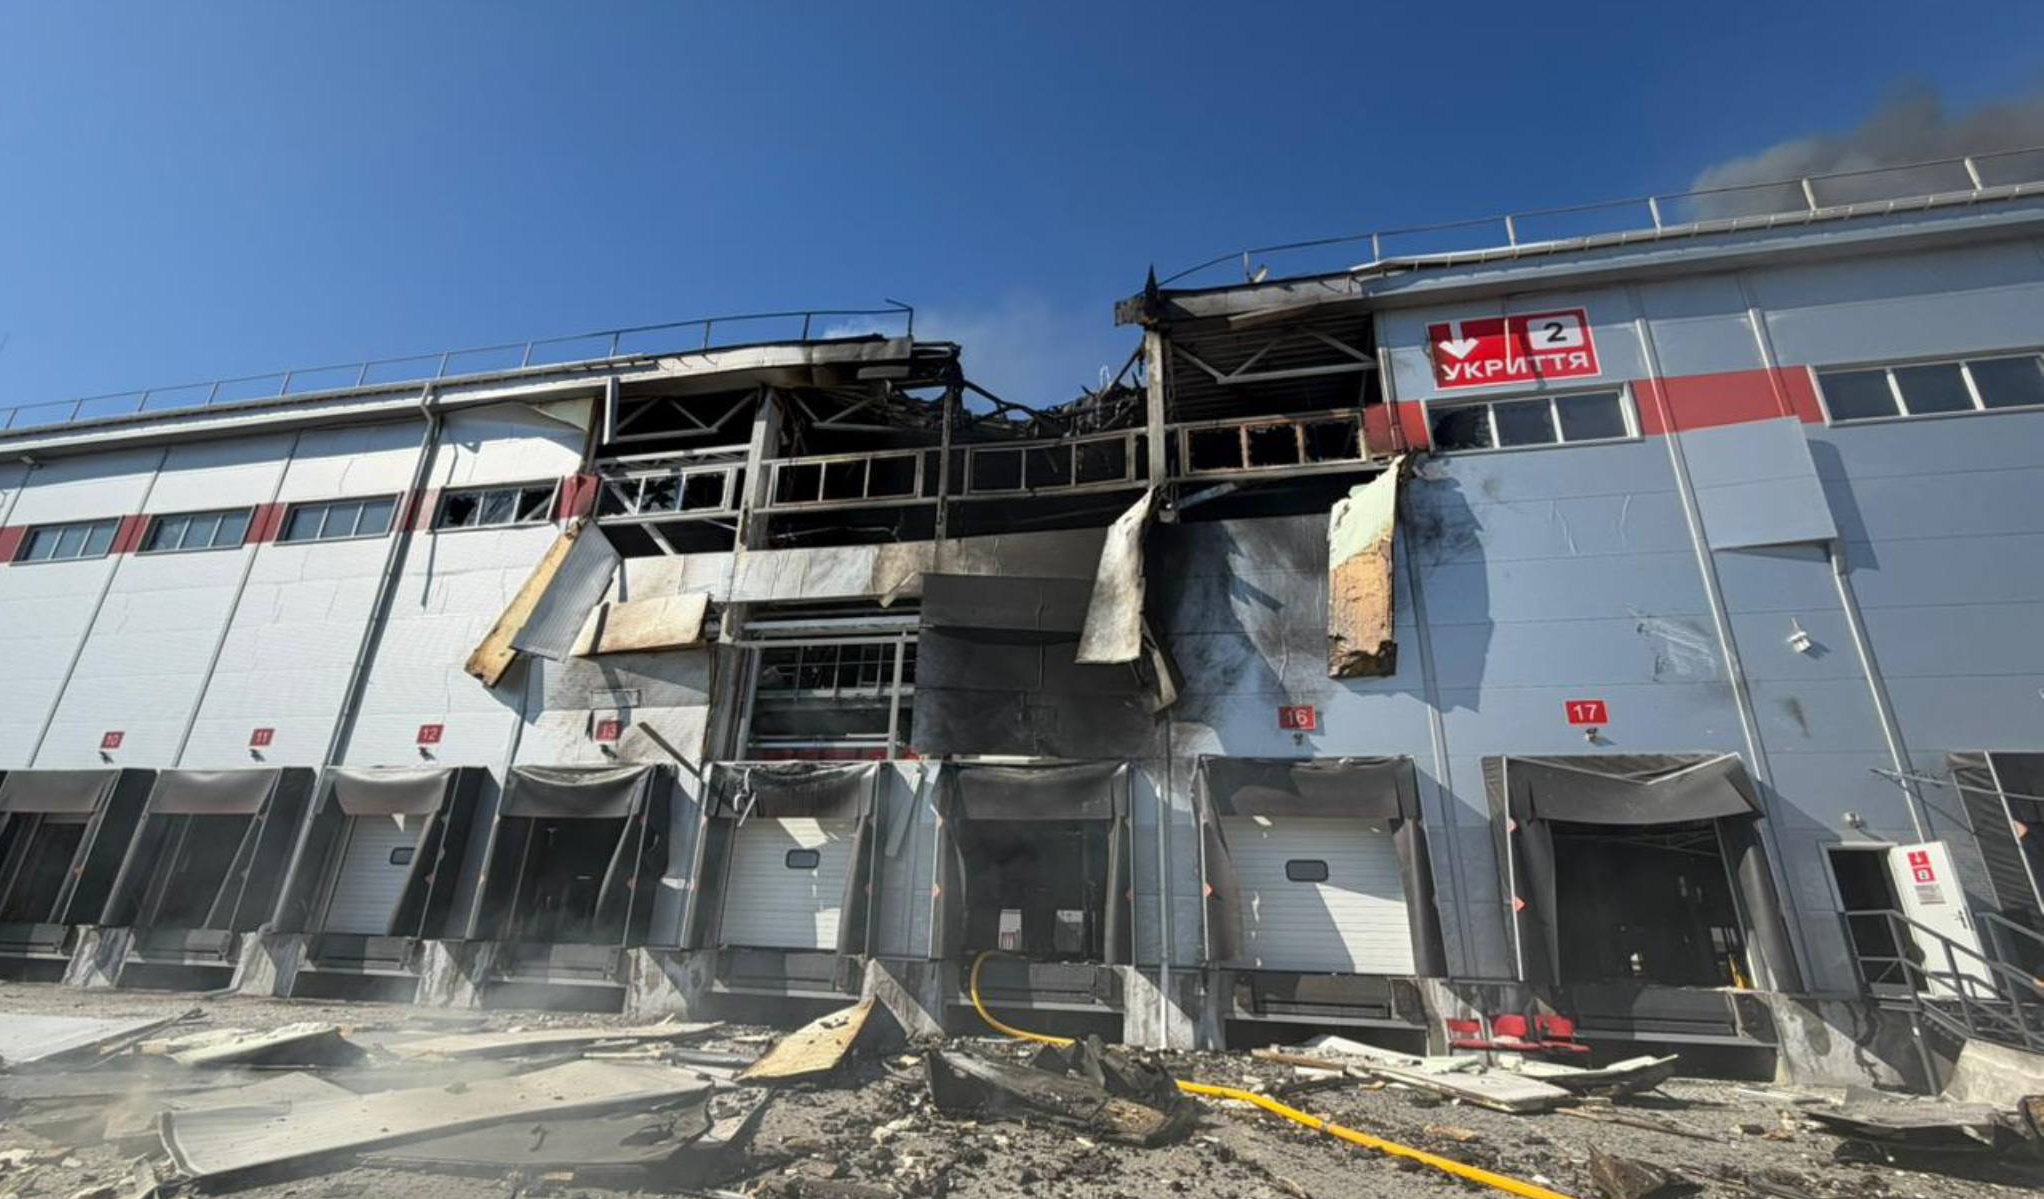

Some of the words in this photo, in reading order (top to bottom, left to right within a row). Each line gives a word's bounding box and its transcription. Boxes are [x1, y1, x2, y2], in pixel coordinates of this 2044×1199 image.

[1543, 322, 1567, 342] 2
[1441, 352, 1589, 380] УКРИТТЯ
[1287, 710, 1308, 725] 16
[1574, 704, 1597, 719] 17
[256, 732, 270, 743] 11
[424, 728, 439, 740] 12
